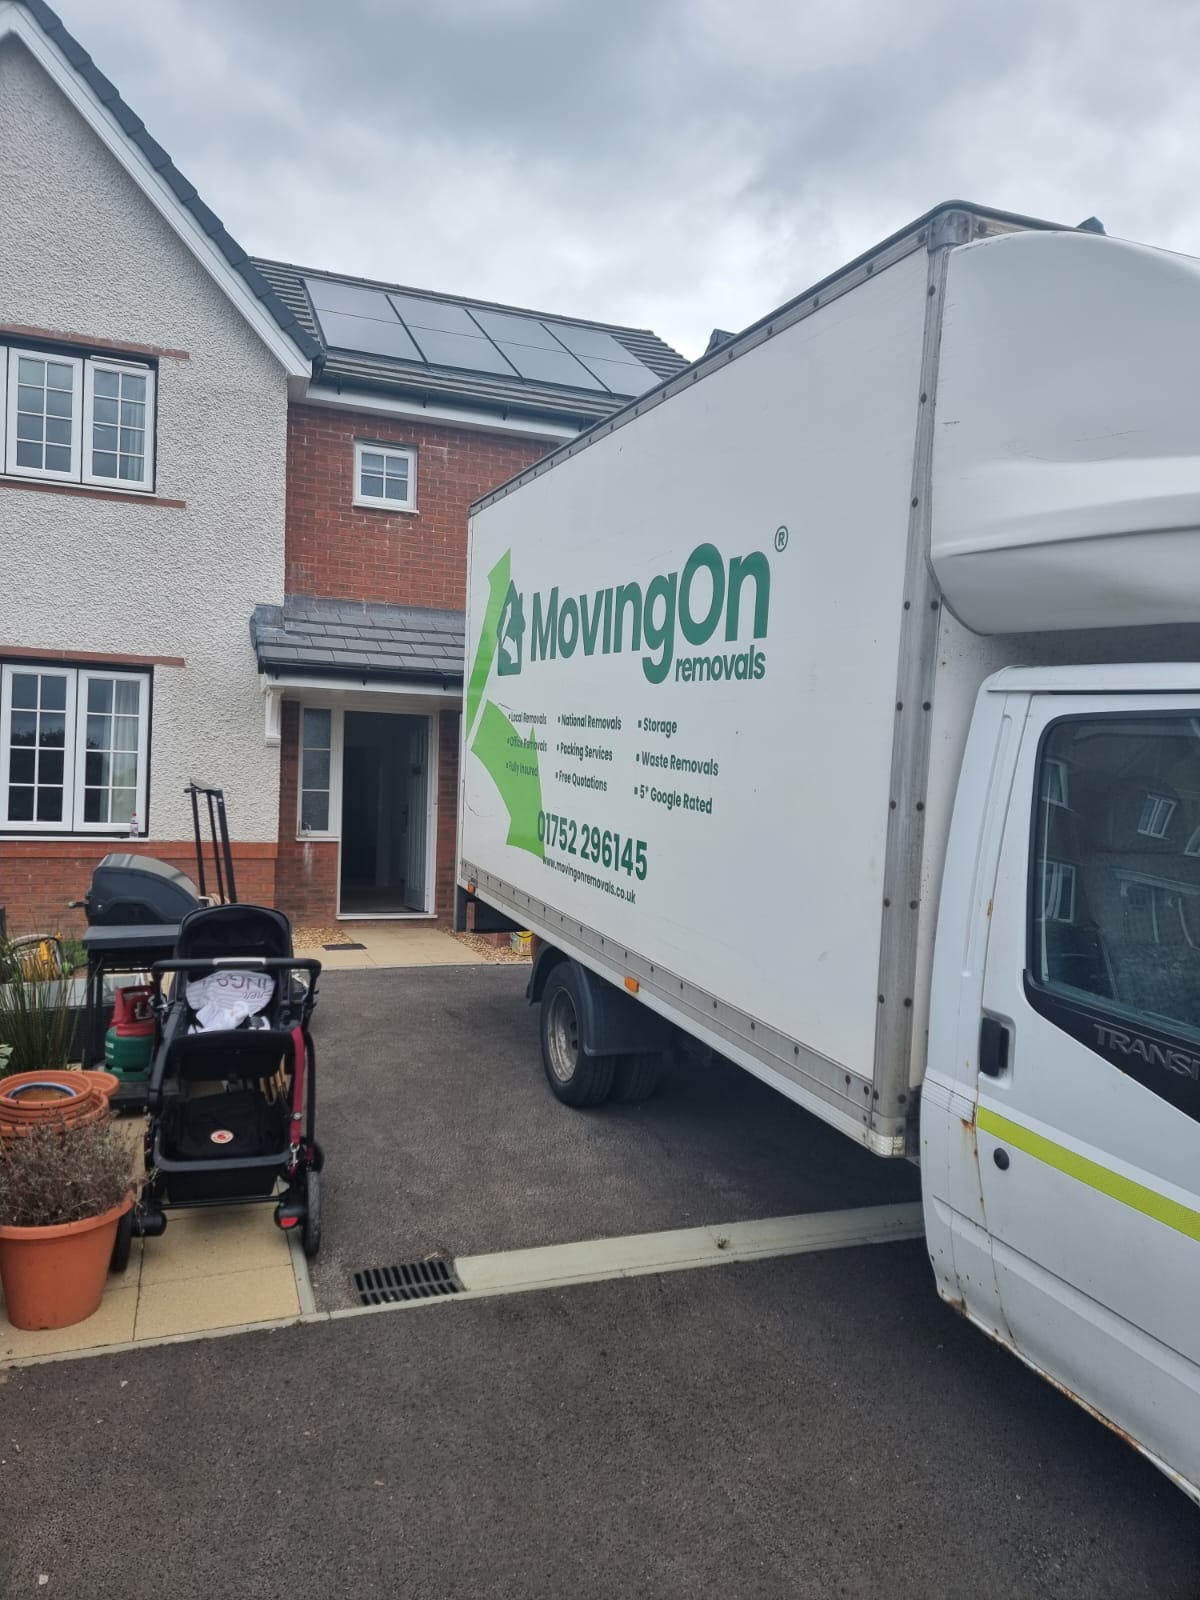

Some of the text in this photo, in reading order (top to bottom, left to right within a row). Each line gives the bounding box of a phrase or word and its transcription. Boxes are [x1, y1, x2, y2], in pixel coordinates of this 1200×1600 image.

[675, 644, 766, 682] removals
[561, 713, 622, 730] National Removals
[643, 717, 677, 738] Storage
[560, 741, 613, 761] Packing Services
[641, 751, 719, 776] Waste Removals
[559, 770, 607, 791] Free Quotations
[650, 787, 682, 811] Google
[682, 792, 713, 814] Rated
[537, 810, 648, 880] 01752 296145
[542, 856, 636, 904] www.movingonremovals.co.uk
[1093, 1024, 1200, 1080] TRANSI
